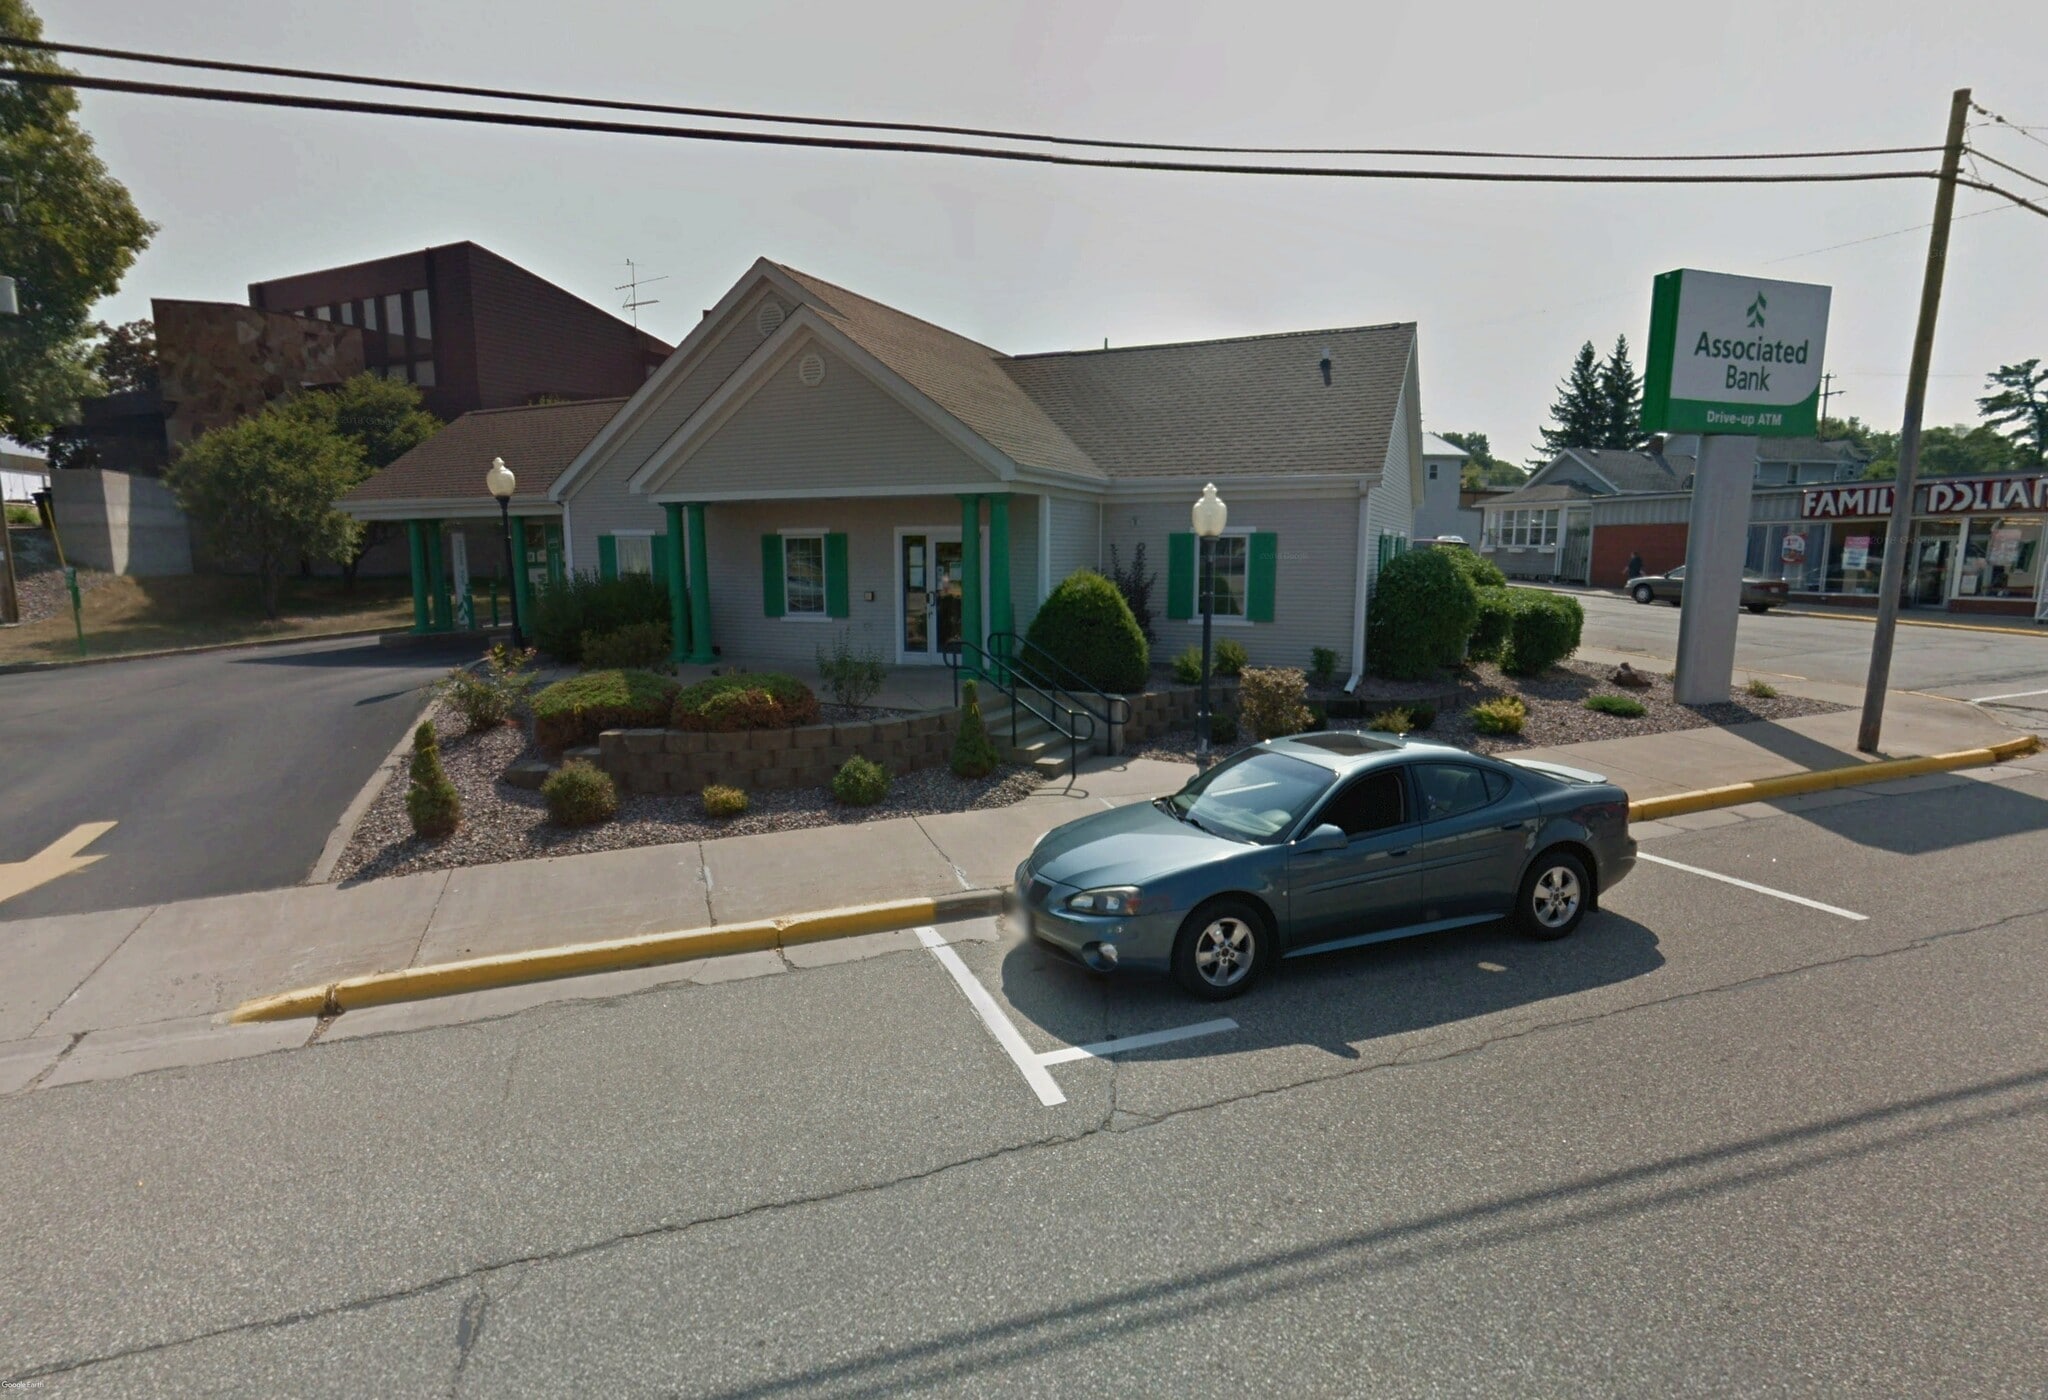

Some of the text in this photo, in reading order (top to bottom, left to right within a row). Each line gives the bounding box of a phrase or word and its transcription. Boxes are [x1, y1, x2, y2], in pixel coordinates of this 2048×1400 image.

[1694, 331, 1809, 365] Associated
[1725, 364, 1770, 392] Bank
[1706, 410, 1783, 426] Drive-up ATM
[1802, 486, 1896, 518] FAMIL
